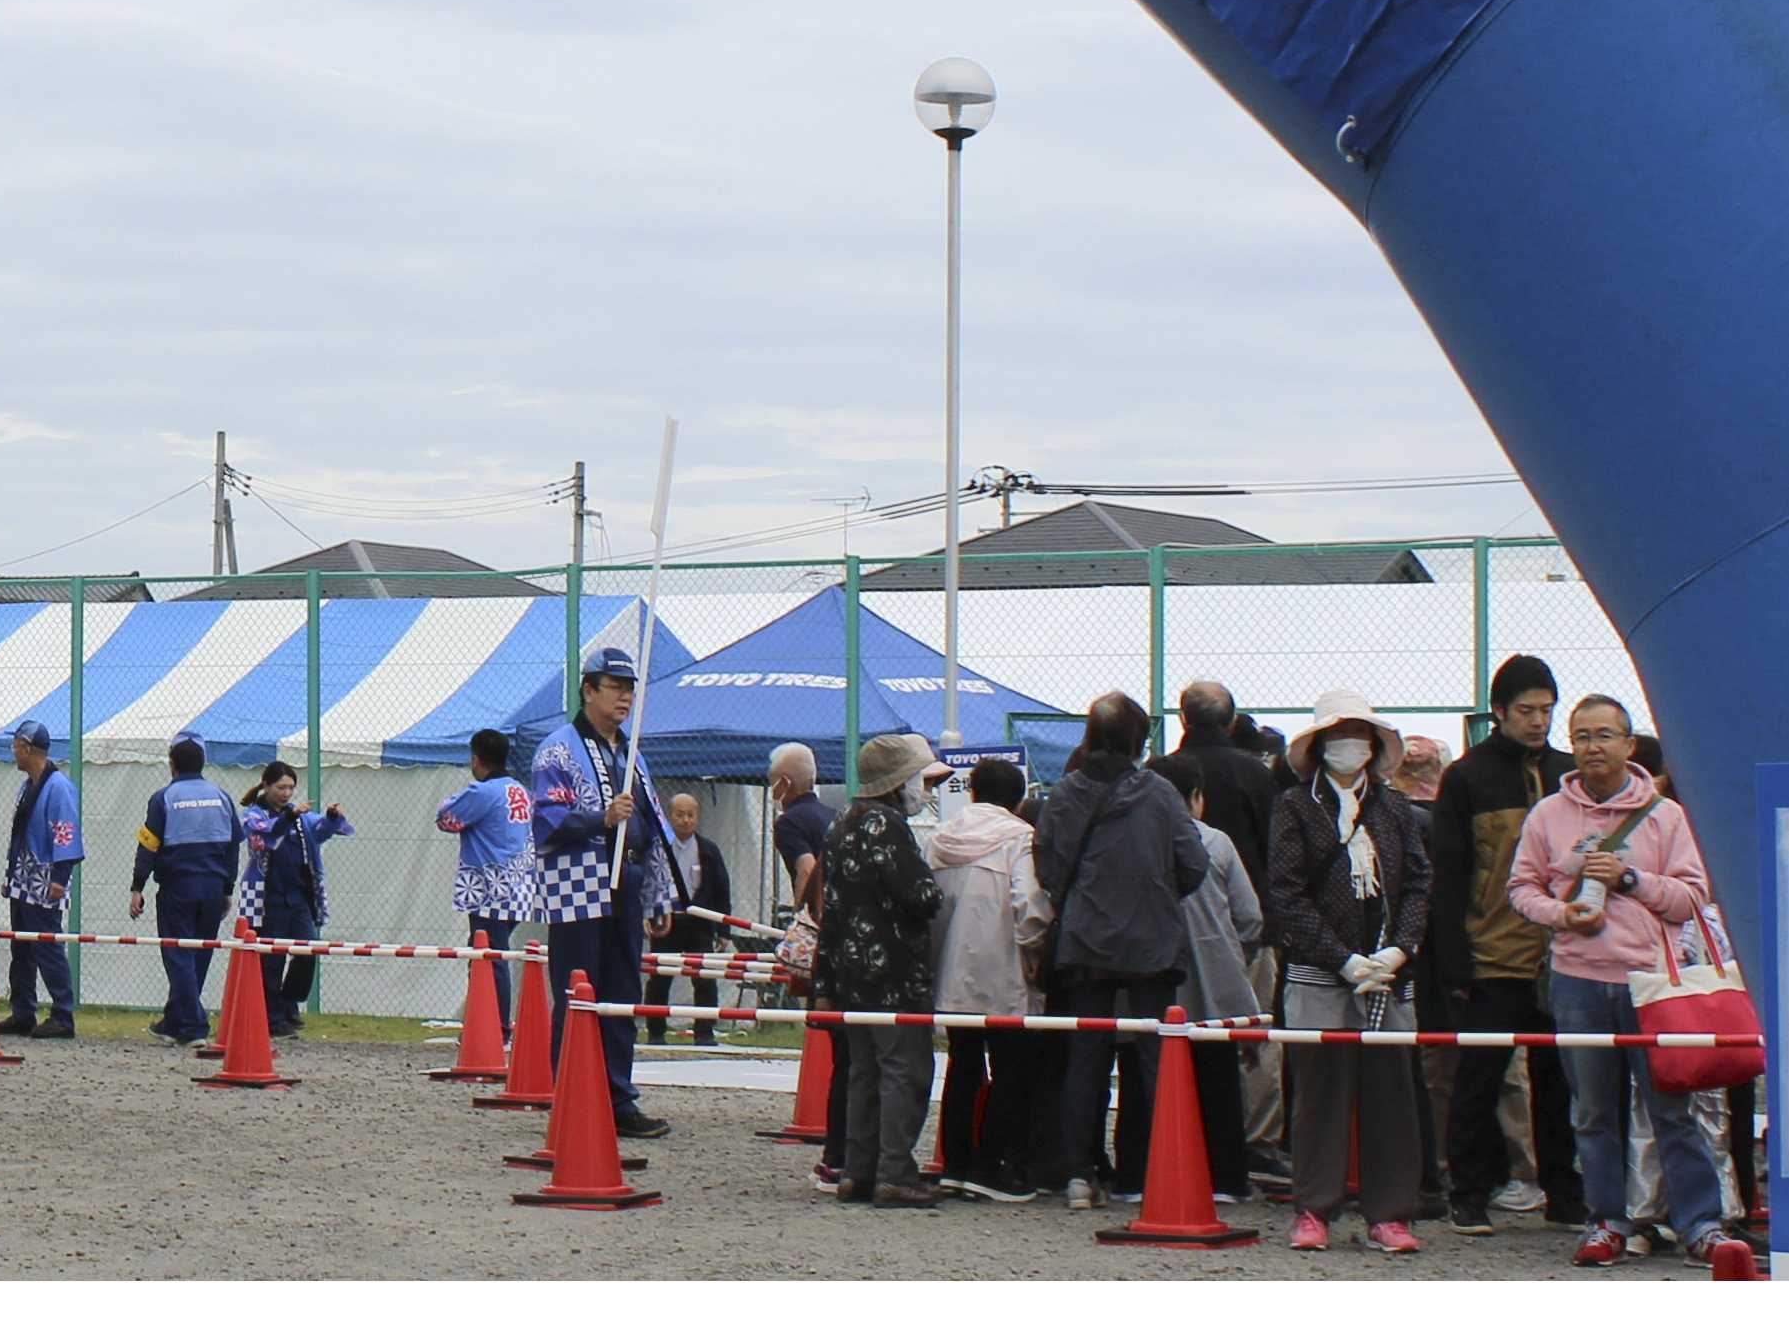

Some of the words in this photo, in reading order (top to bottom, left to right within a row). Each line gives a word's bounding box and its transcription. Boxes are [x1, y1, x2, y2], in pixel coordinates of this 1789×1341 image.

[676, 672, 763, 688] TOYO
[761, 672, 849, 690] TIRES
[877, 676, 940, 694] TOYO
[929, 677, 996, 695] TRES
[945, 753, 980, 765] TOYO
